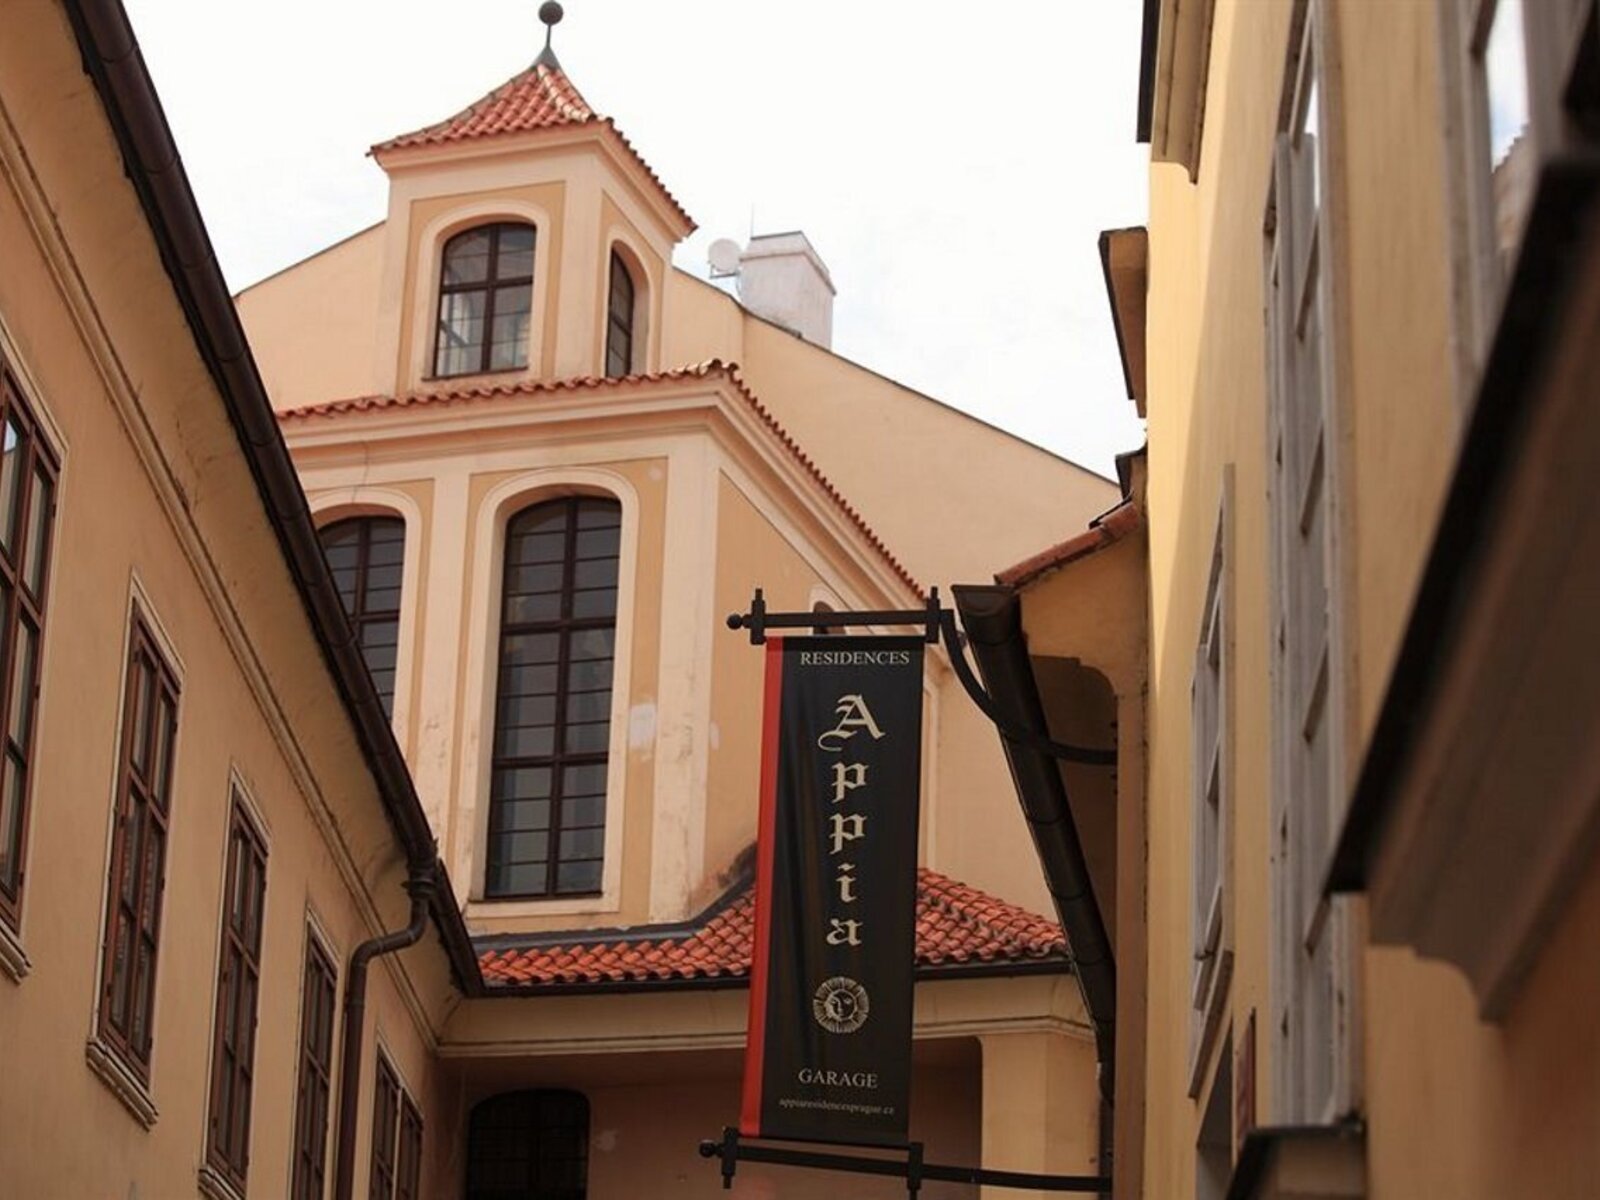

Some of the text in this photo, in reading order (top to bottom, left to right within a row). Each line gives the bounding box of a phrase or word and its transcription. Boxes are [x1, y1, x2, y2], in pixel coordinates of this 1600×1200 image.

[800, 651, 910, 665] RESIDENCES
[817, 693, 886, 946] Appia
[798, 1067, 879, 1088] GARAGE
